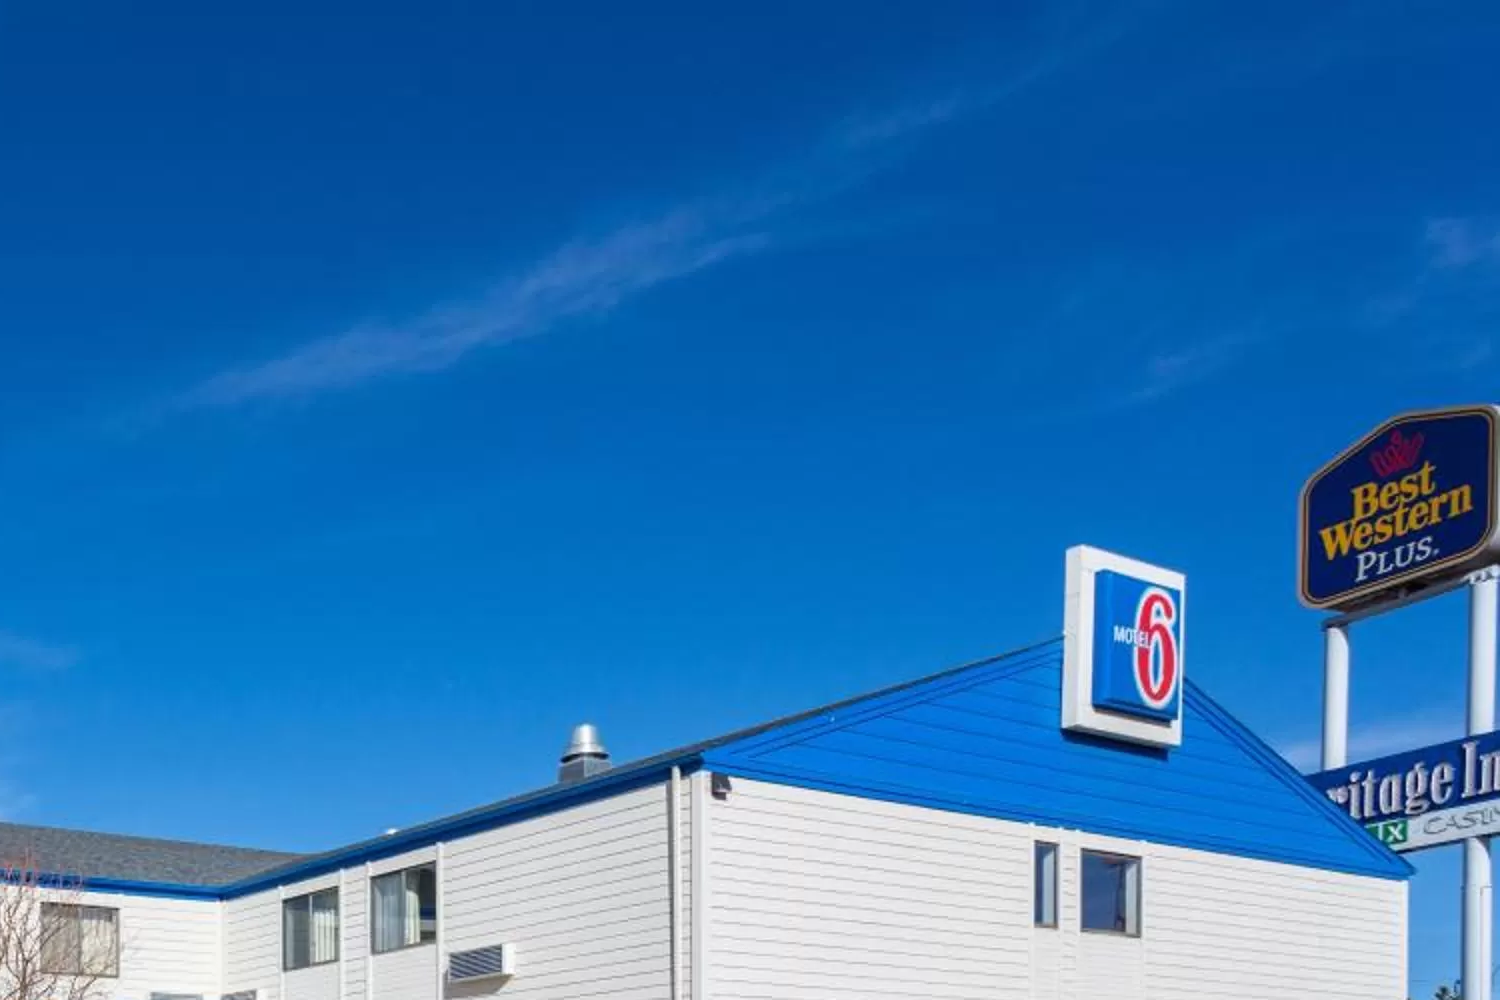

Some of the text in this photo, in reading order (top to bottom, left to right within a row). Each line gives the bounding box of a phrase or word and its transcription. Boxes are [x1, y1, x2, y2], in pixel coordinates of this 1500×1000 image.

[1319, 484, 1475, 561] Western
[1352, 460, 1437, 521] Best
[1113, 587, 1179, 709] MOTEL 6
